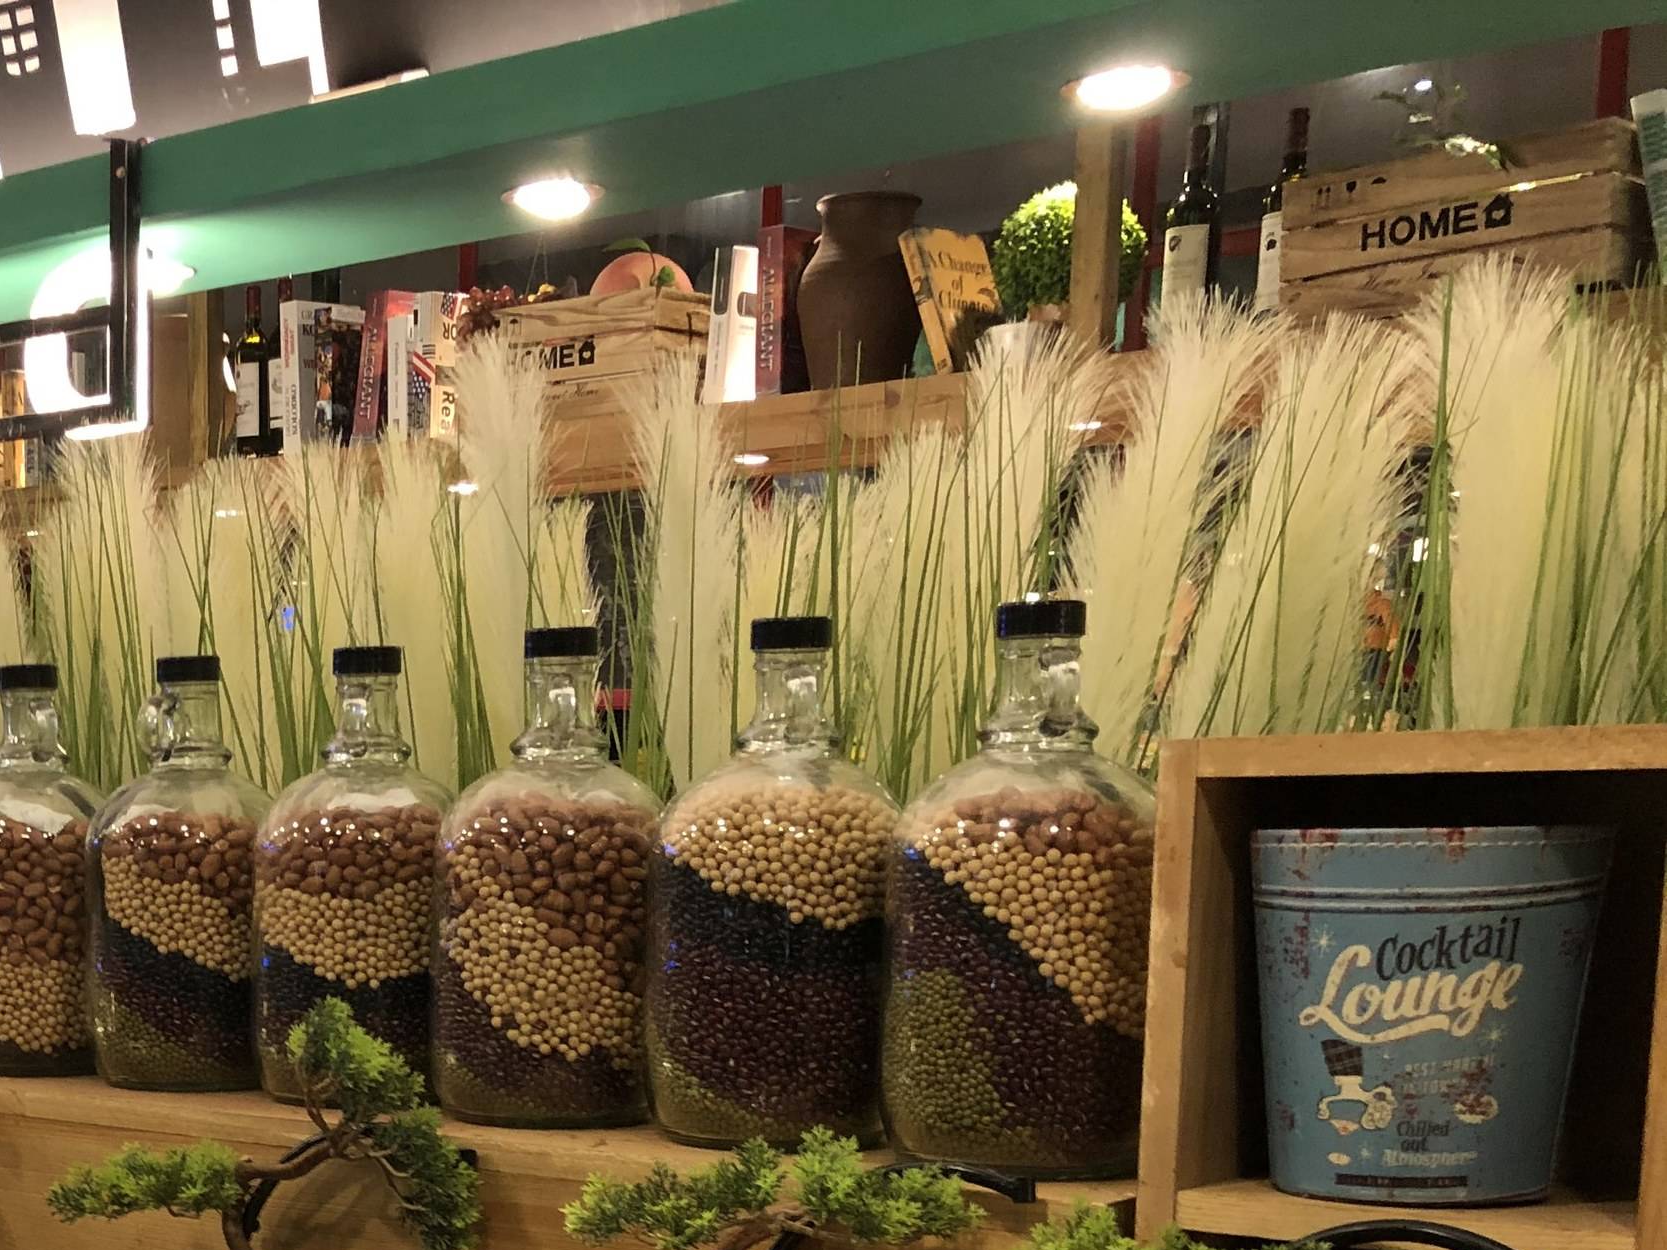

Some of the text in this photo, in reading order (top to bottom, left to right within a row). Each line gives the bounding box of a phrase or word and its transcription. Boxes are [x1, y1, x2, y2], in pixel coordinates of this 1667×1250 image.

[1361, 201, 1479, 252] HOME
[951, 275, 964, 297] of
[1376, 917, 1522, 981] Cocktail
[1298, 944, 1524, 1044] Lounge
